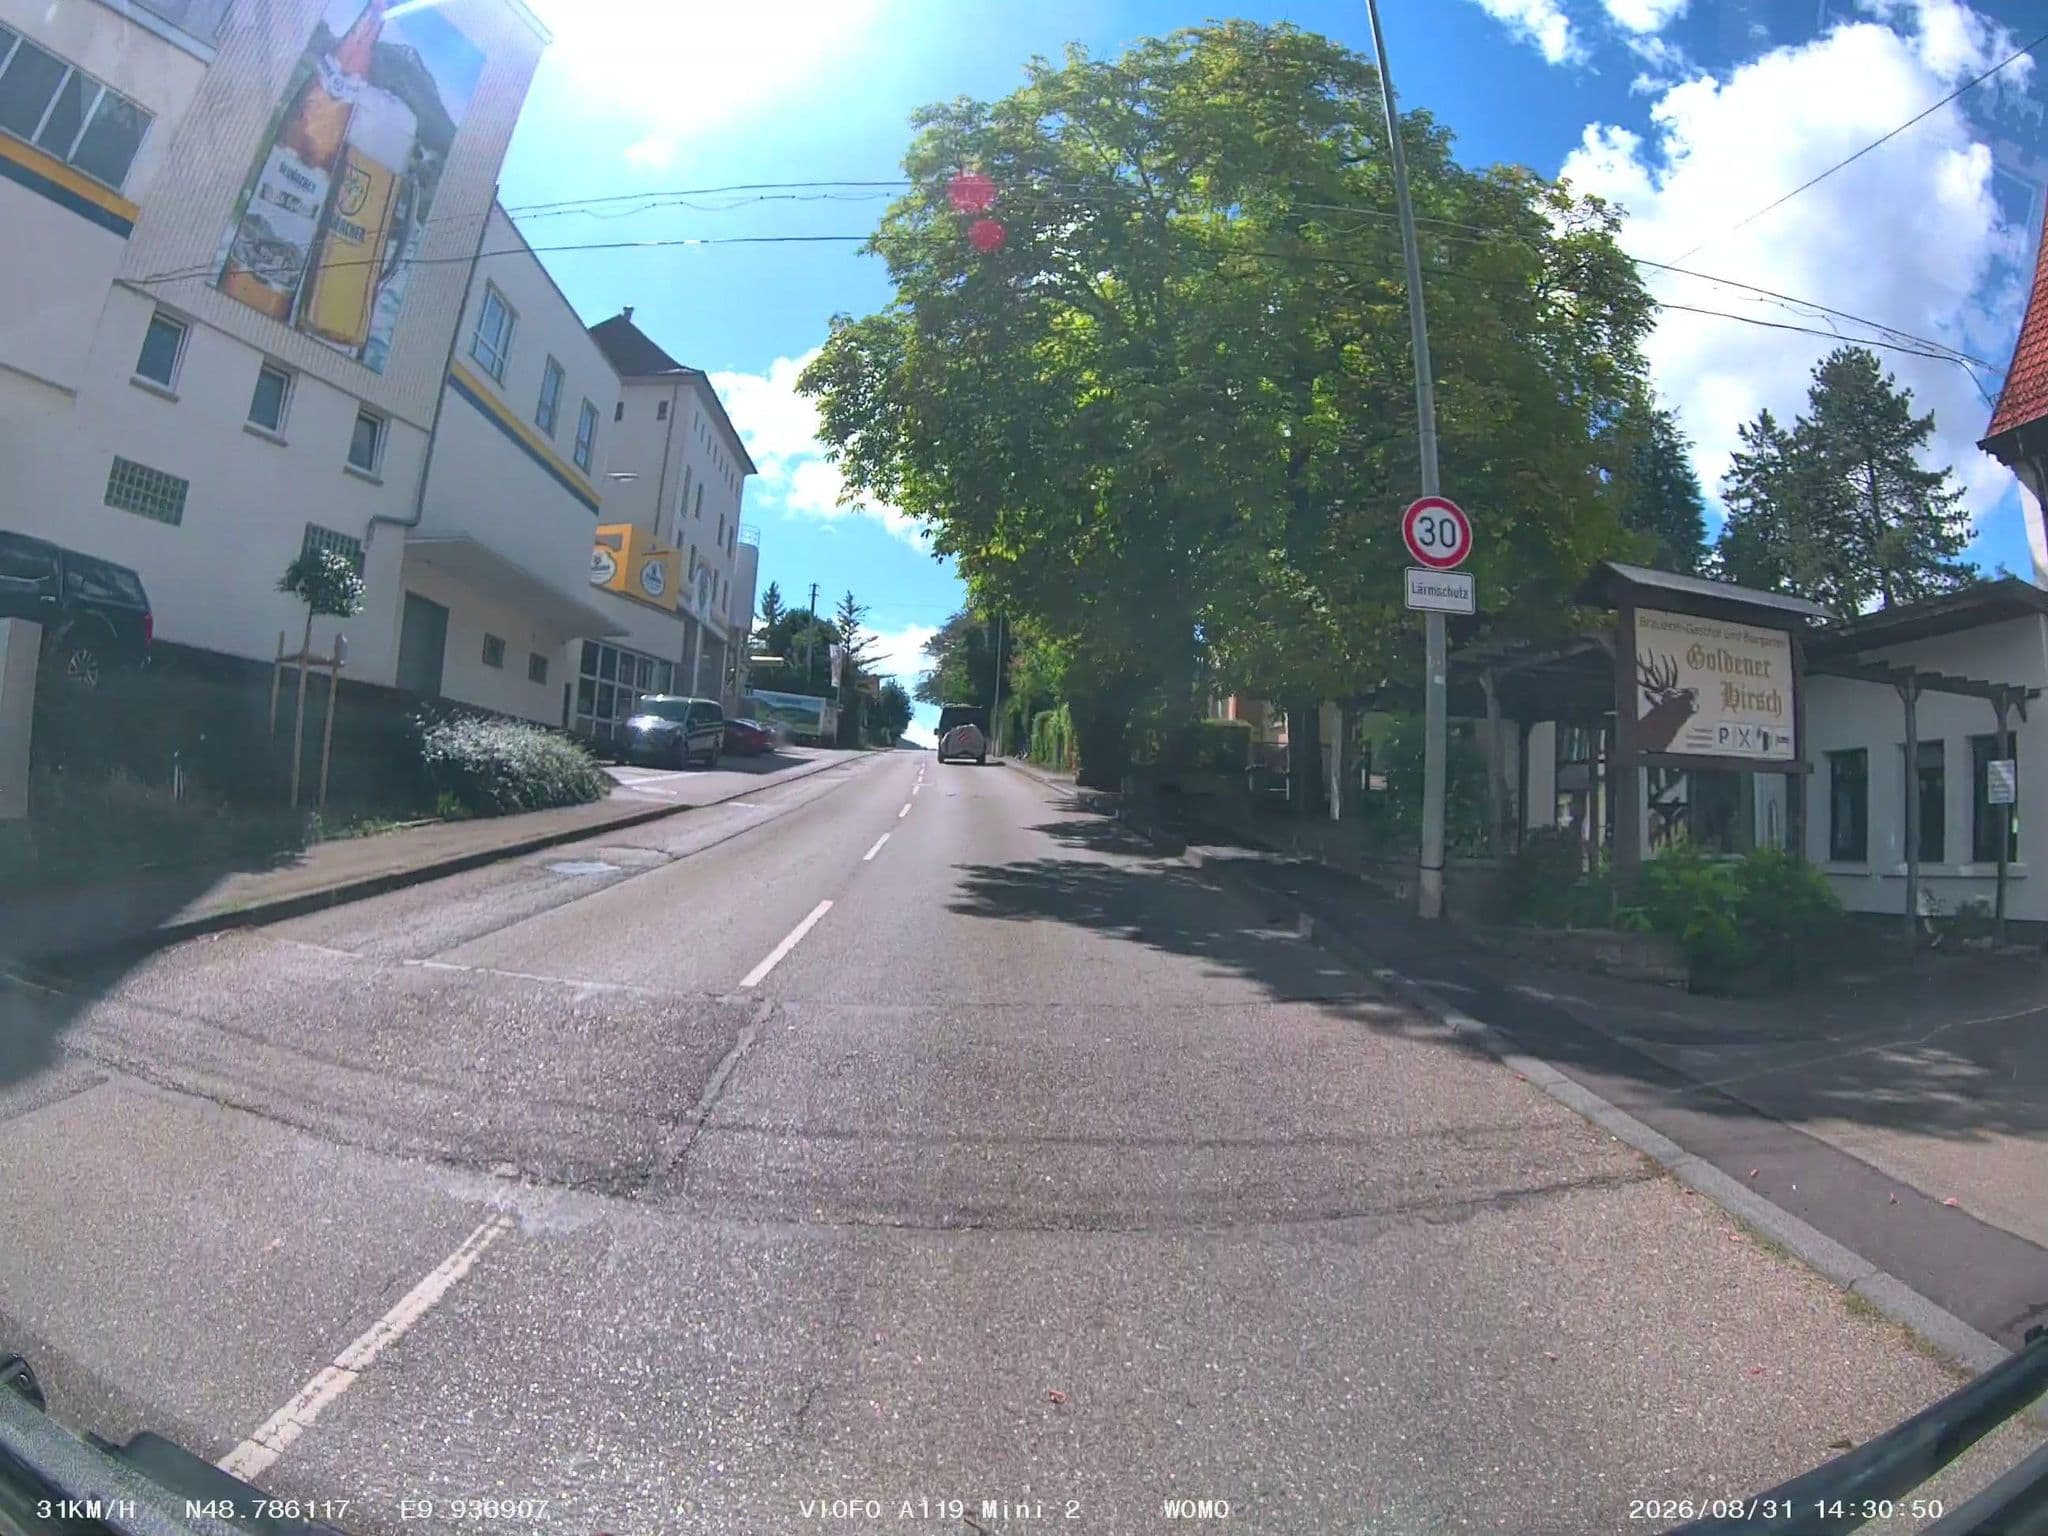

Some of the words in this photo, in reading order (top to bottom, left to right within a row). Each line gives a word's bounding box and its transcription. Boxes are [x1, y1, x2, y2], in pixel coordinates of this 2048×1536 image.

[1419, 516, 1456, 548] 30
[1411, 581, 1469, 600] Lärmschutz
[1686, 642, 1772, 678] Goldener
[1720, 680, 1782, 717] Hirsch
[1719, 727, 1730, 744] P
